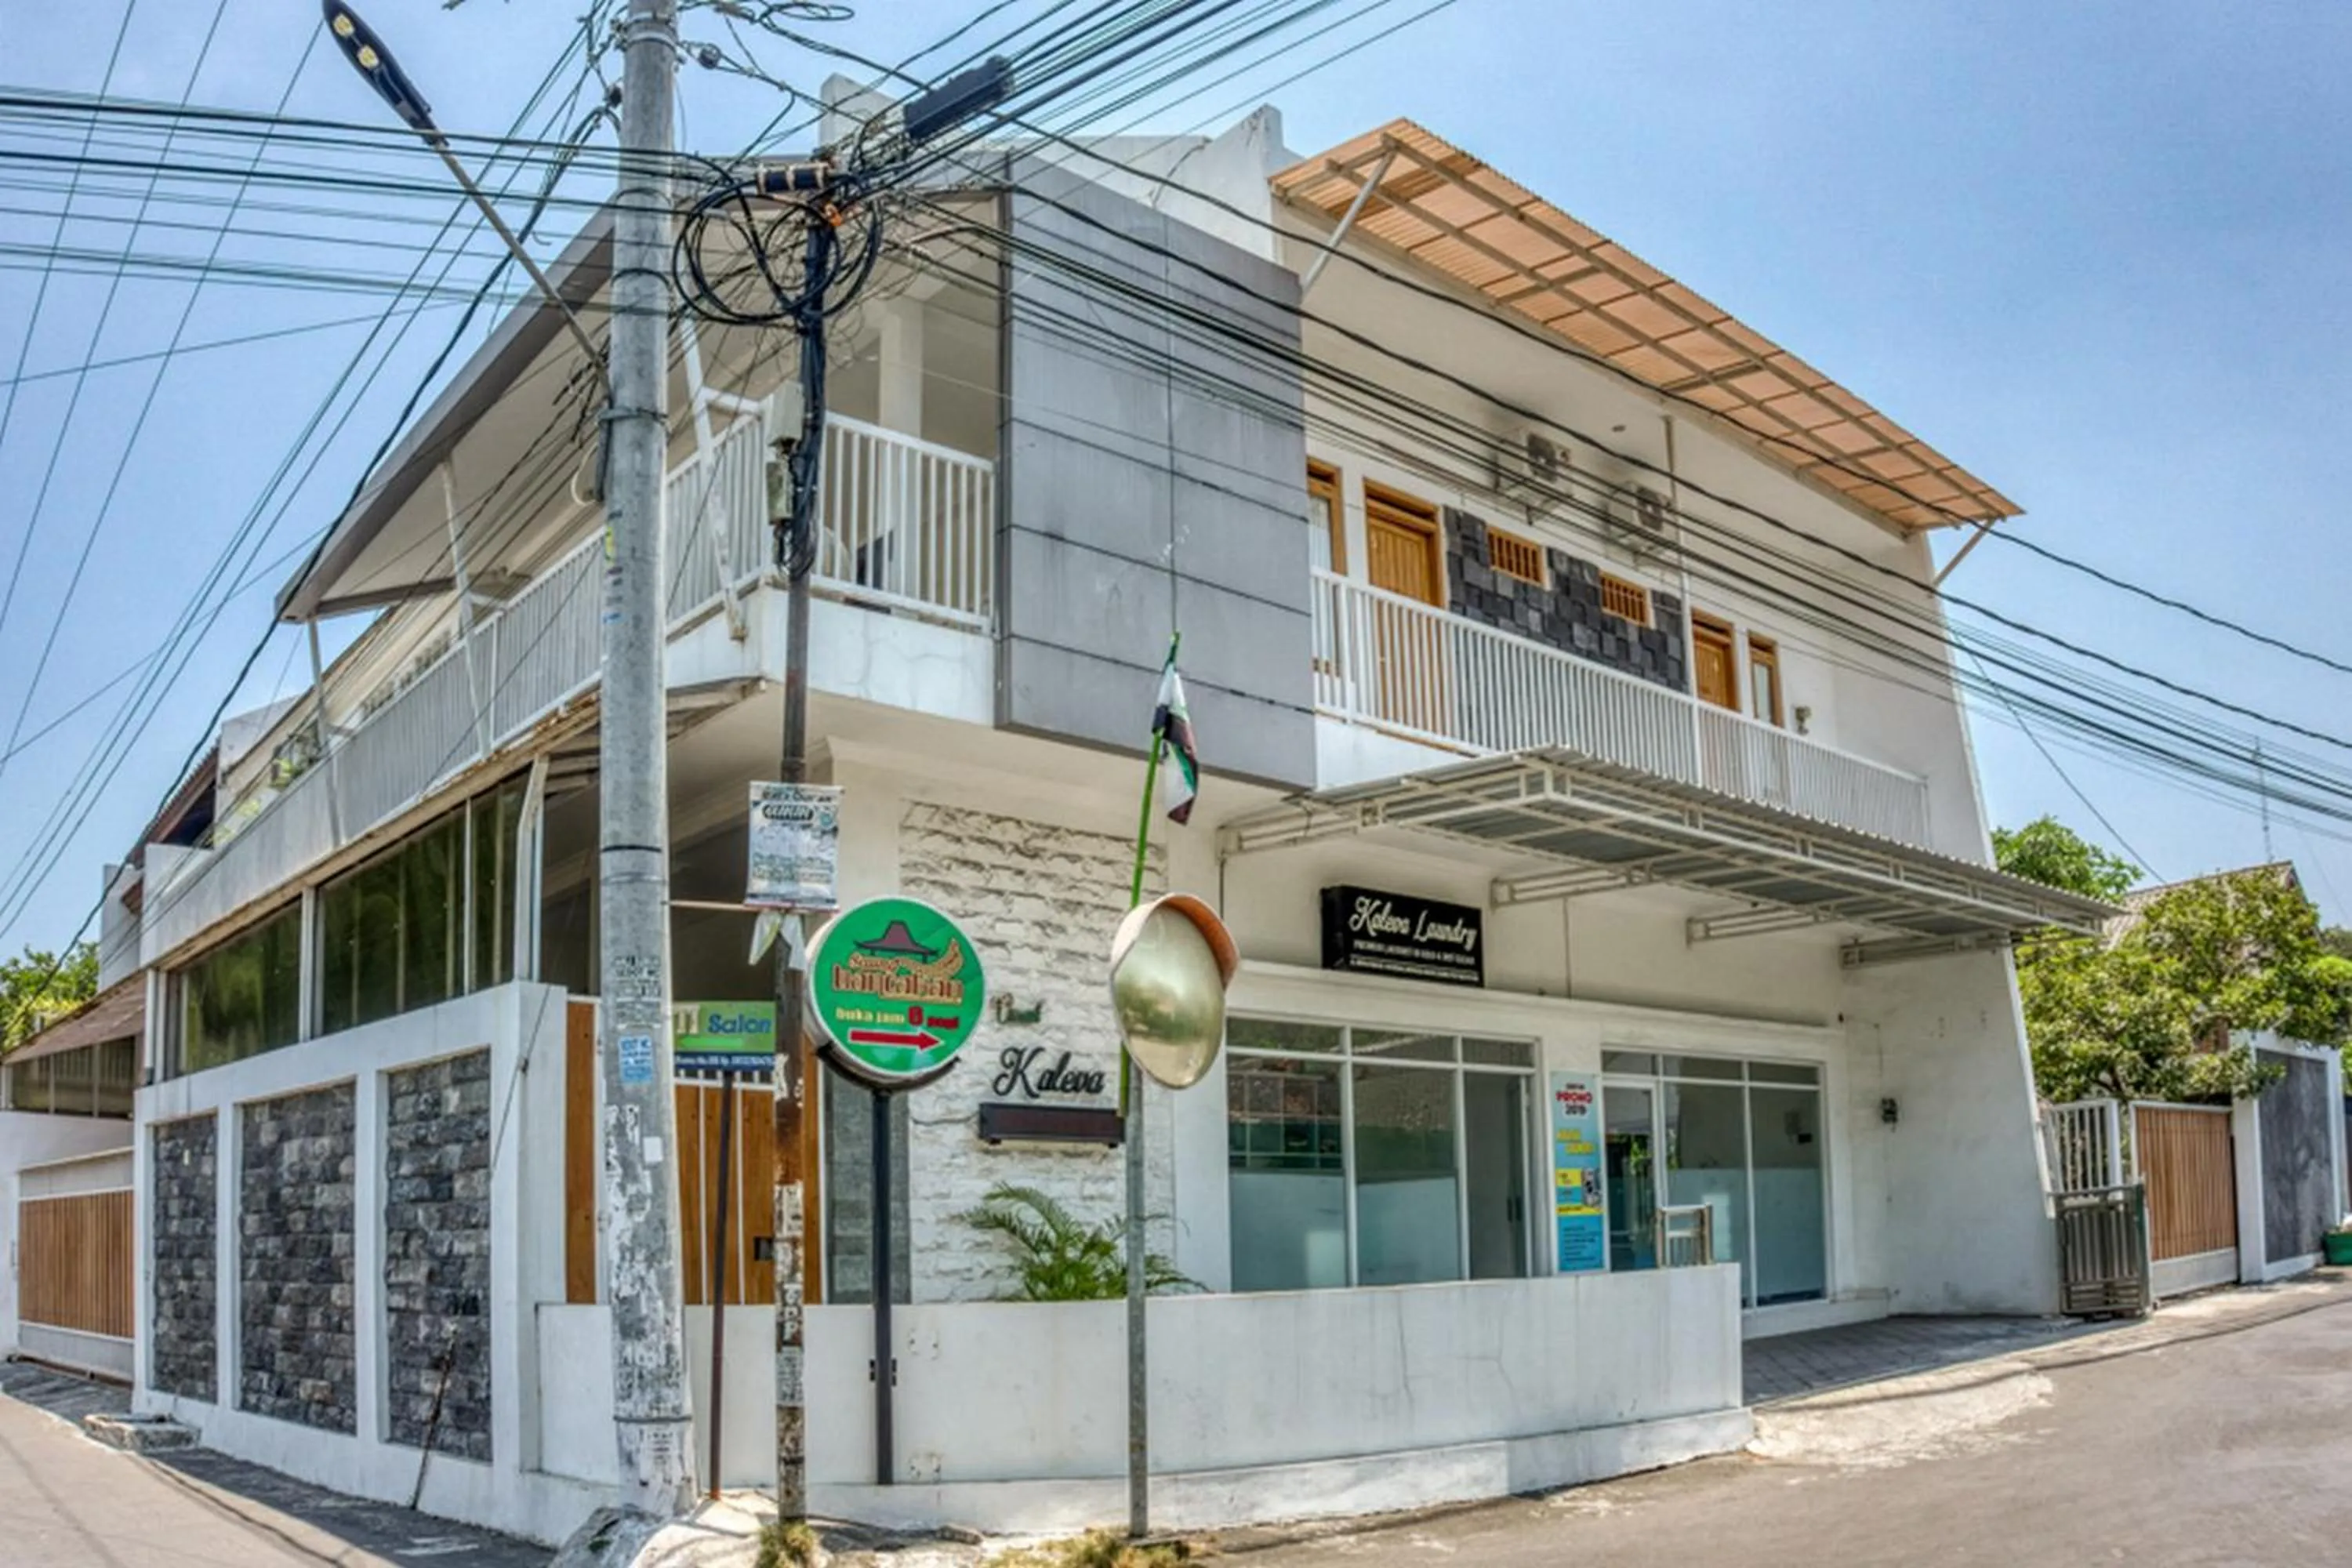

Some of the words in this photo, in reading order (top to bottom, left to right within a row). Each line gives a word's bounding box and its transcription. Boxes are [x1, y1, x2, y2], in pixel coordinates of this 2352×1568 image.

[1413, 909, 1478, 951] Laundry
[708, 1013, 771, 1033] Salon
[993, 1047, 1105, 1098] Kaleva
[1555, 1091, 1593, 1104] PROMO
